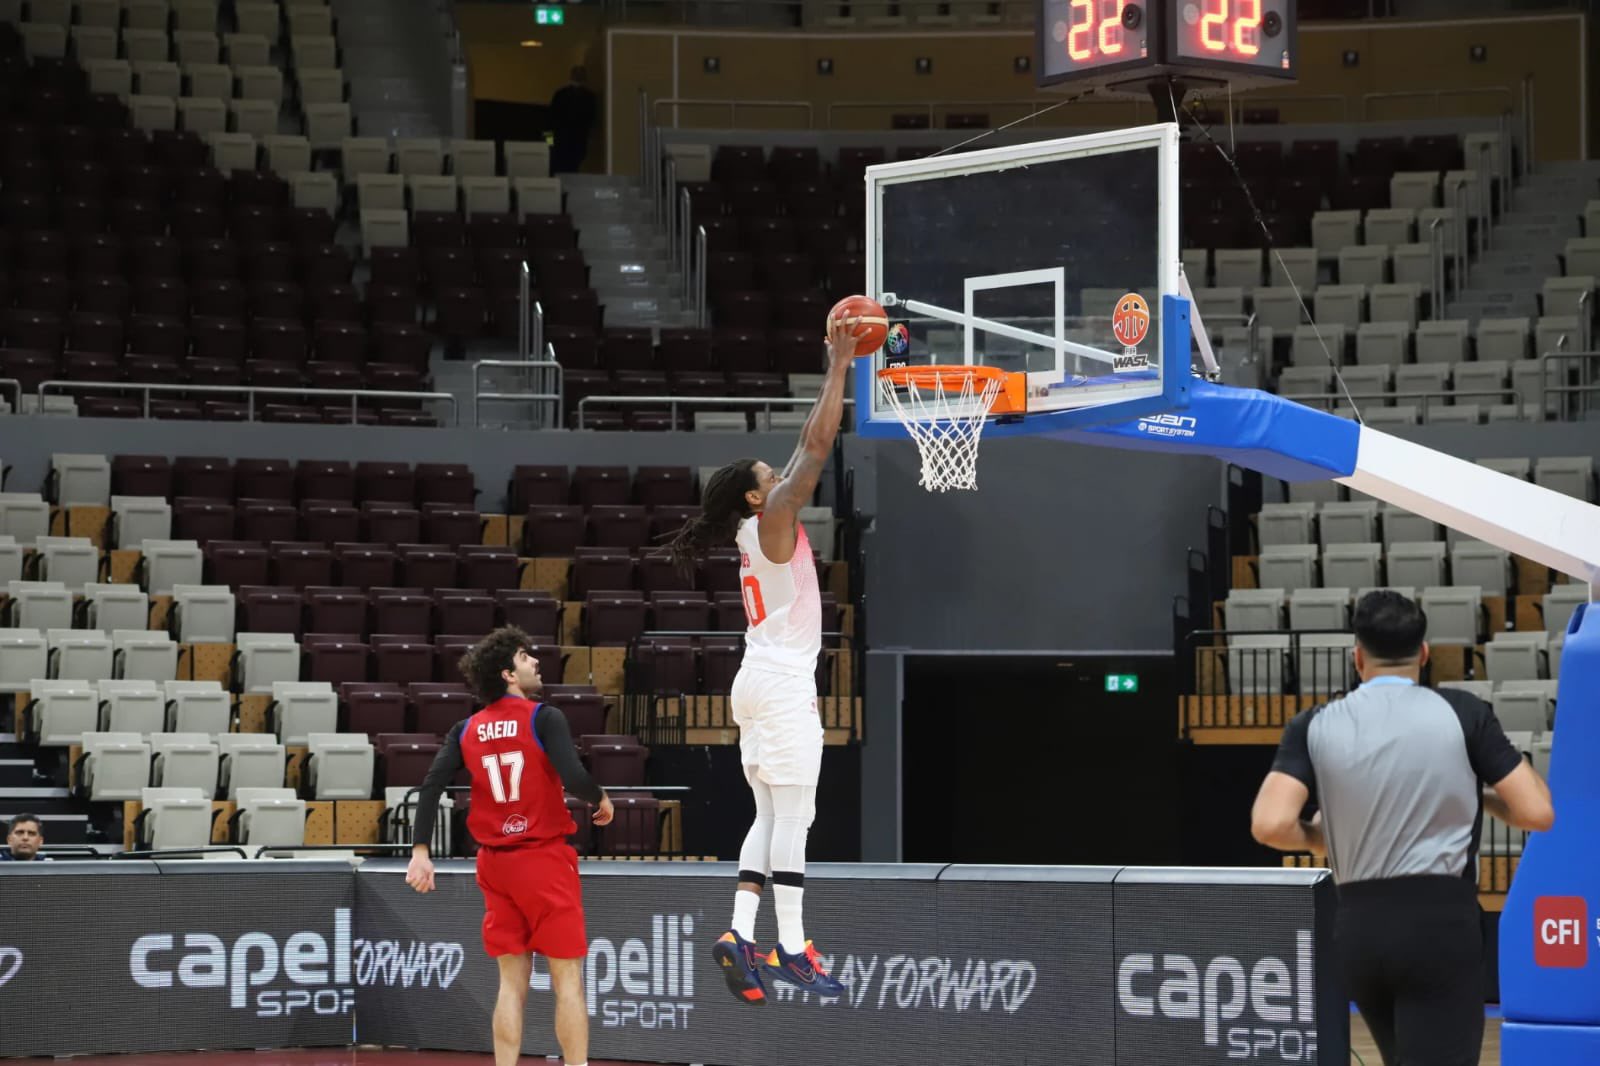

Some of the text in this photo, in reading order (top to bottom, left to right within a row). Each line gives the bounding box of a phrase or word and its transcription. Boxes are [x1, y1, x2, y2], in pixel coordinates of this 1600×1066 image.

[1068, 0, 1125, 61] 22
[1200, 0, 1262, 55] 22
[477, 720, 518, 742] SAEID
[481, 751, 525, 803] 17
[129, 908, 351, 1008] capel
[1541, 918, 1580, 945] CFI
[876, 954, 1038, 1014] FORWARD
[1118, 930, 1313, 1046] capel
[601, 999, 695, 1029] SPORT
